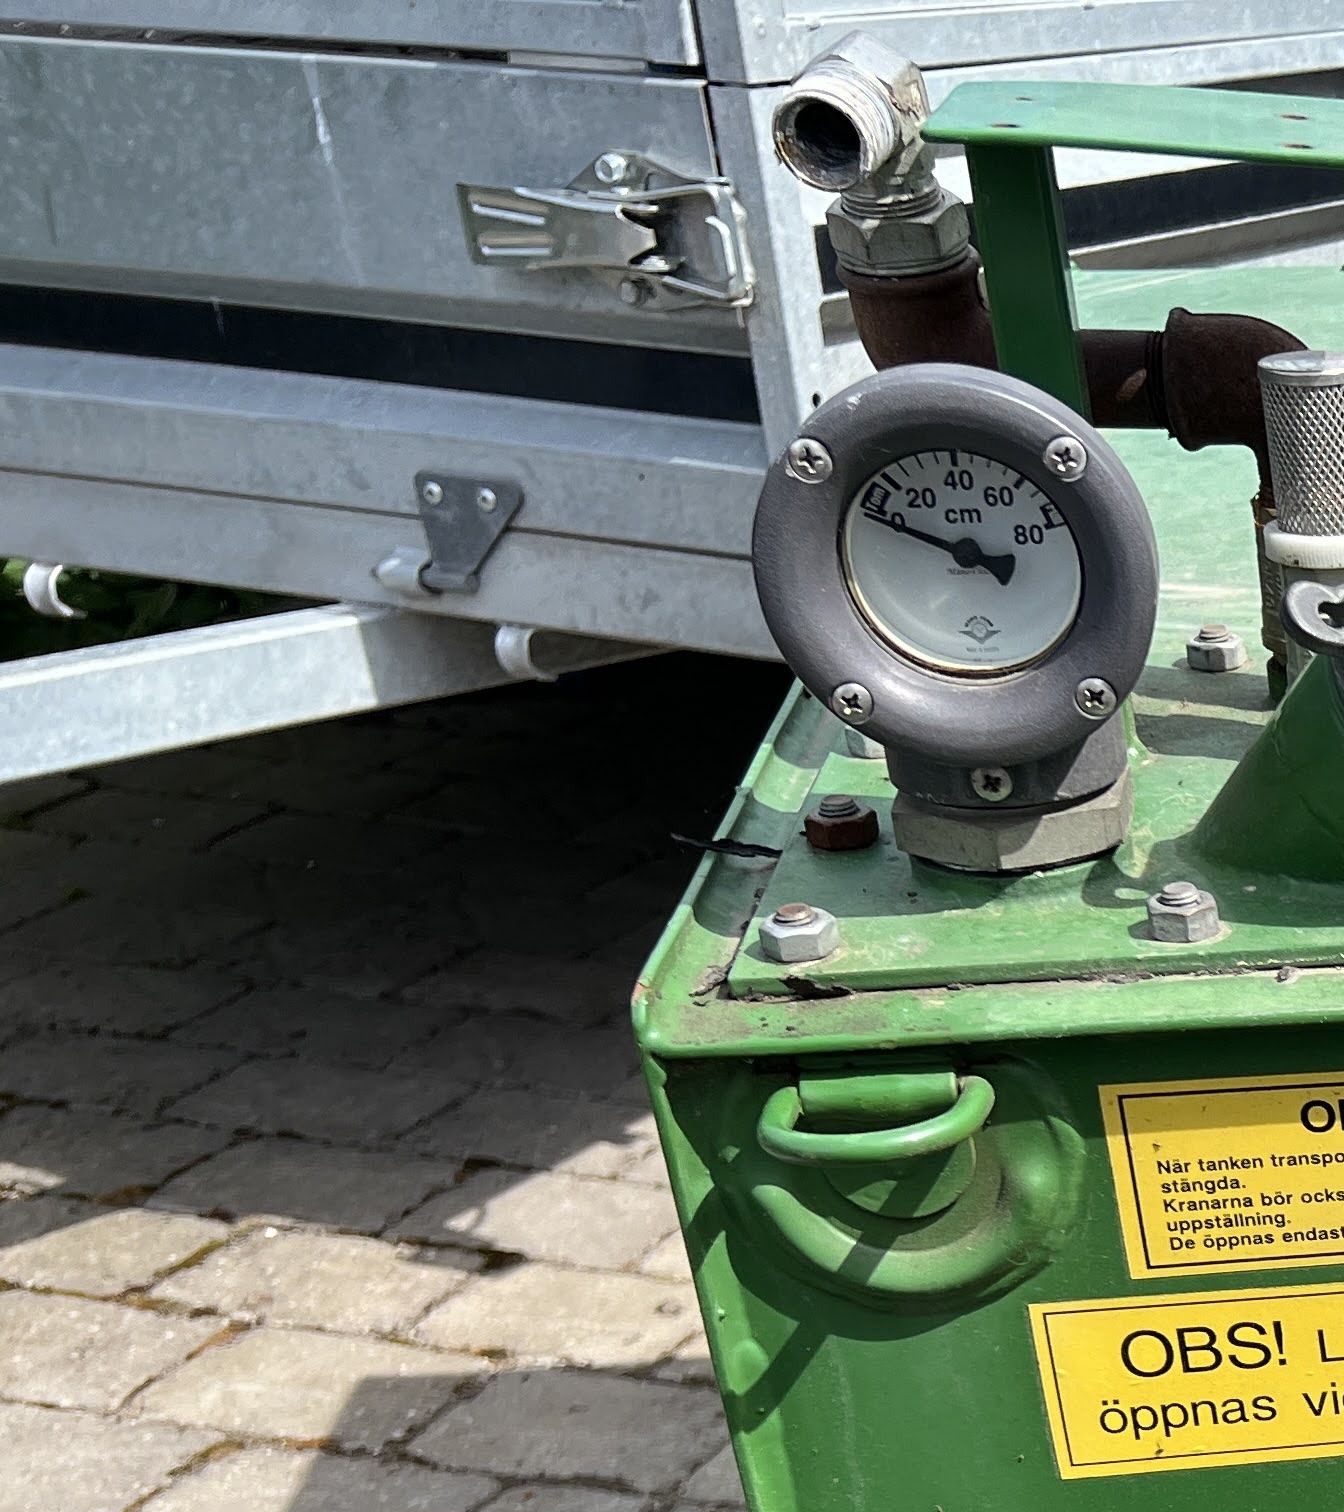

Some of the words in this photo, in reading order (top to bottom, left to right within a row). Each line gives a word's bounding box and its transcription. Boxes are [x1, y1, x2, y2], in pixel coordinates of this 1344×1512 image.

[944, 469, 974, 490] 40
[905, 488, 937, 509] 20
[984, 486, 1014, 507] 60
[945, 508, 982, 524] cm
[1014, 524, 1044, 545] 80
[1157, 1159, 1192, 1175] När
[1198, 1155, 1264, 1172] tanken
[1161, 1176, 1247, 1194] stängda.
[1163, 1195, 1254, 1213] Kranarna
[1261, 1191, 1293, 1207] bör
[1167, 1212, 1292, 1234] uppställning.
[1170, 1236, 1196, 1250] De
[1203, 1232, 1275, 1251] öppnas
[1120, 1320, 1288, 1378] OBS!
[1099, 1392, 1278, 1441] öppnas
